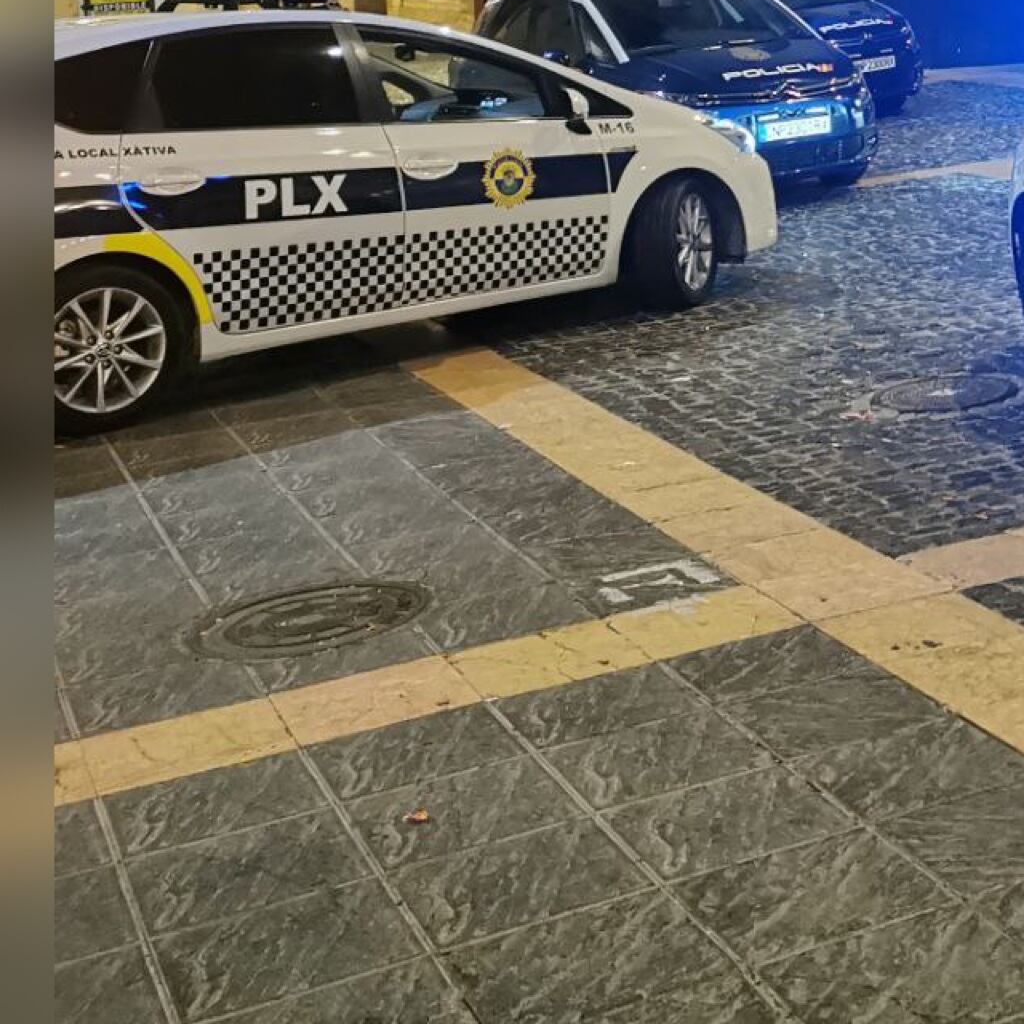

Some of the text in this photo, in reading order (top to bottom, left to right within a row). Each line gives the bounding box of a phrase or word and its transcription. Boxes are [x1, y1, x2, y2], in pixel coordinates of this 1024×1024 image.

[819, 18, 887, 33] POLICIA
[722, 63, 819, 81] POLICIA
[598, 121, 635, 134] M-16
[68, 148, 118, 159] LOCAL
[244, 174, 348, 219] PLX
